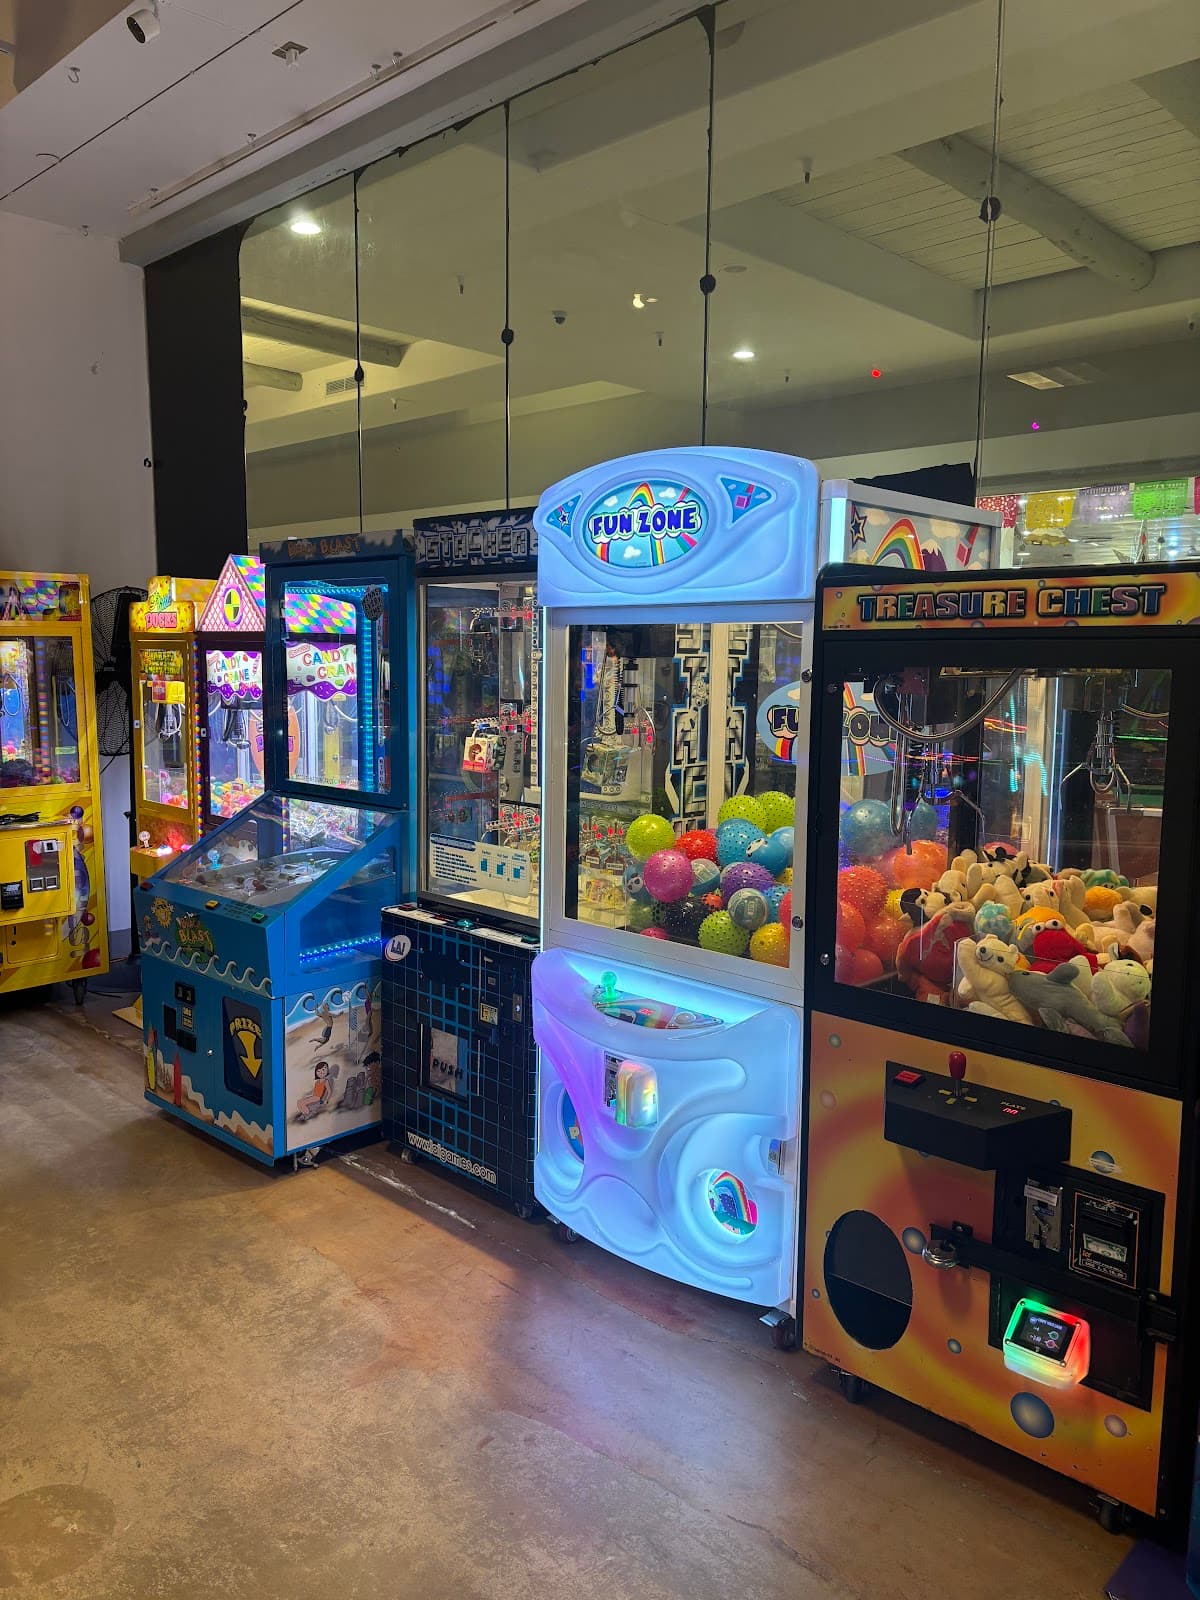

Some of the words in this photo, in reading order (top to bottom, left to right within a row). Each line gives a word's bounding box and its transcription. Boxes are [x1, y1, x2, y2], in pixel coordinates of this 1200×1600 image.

[591, 512, 634, 538] FUN
[638, 505, 698, 534] ZONE
[320, 536, 361, 556] BLAST
[425, 526, 530, 561] STACKER
[857, 589, 1027, 622] TREASURE
[1037, 584, 1167, 616] CHEST
[215, 654, 241, 673] CANDY
[302, 649, 350, 666] CANDY
[223, 668, 250, 684] CRANE
[316, 663, 356, 679] CRAN
[391, 939, 406, 956] LAI
[229, 1017, 262, 1039] PRIZE
[432, 1058, 464, 1080] PUSH
[407, 1131, 497, 1185] www.laigames.com
